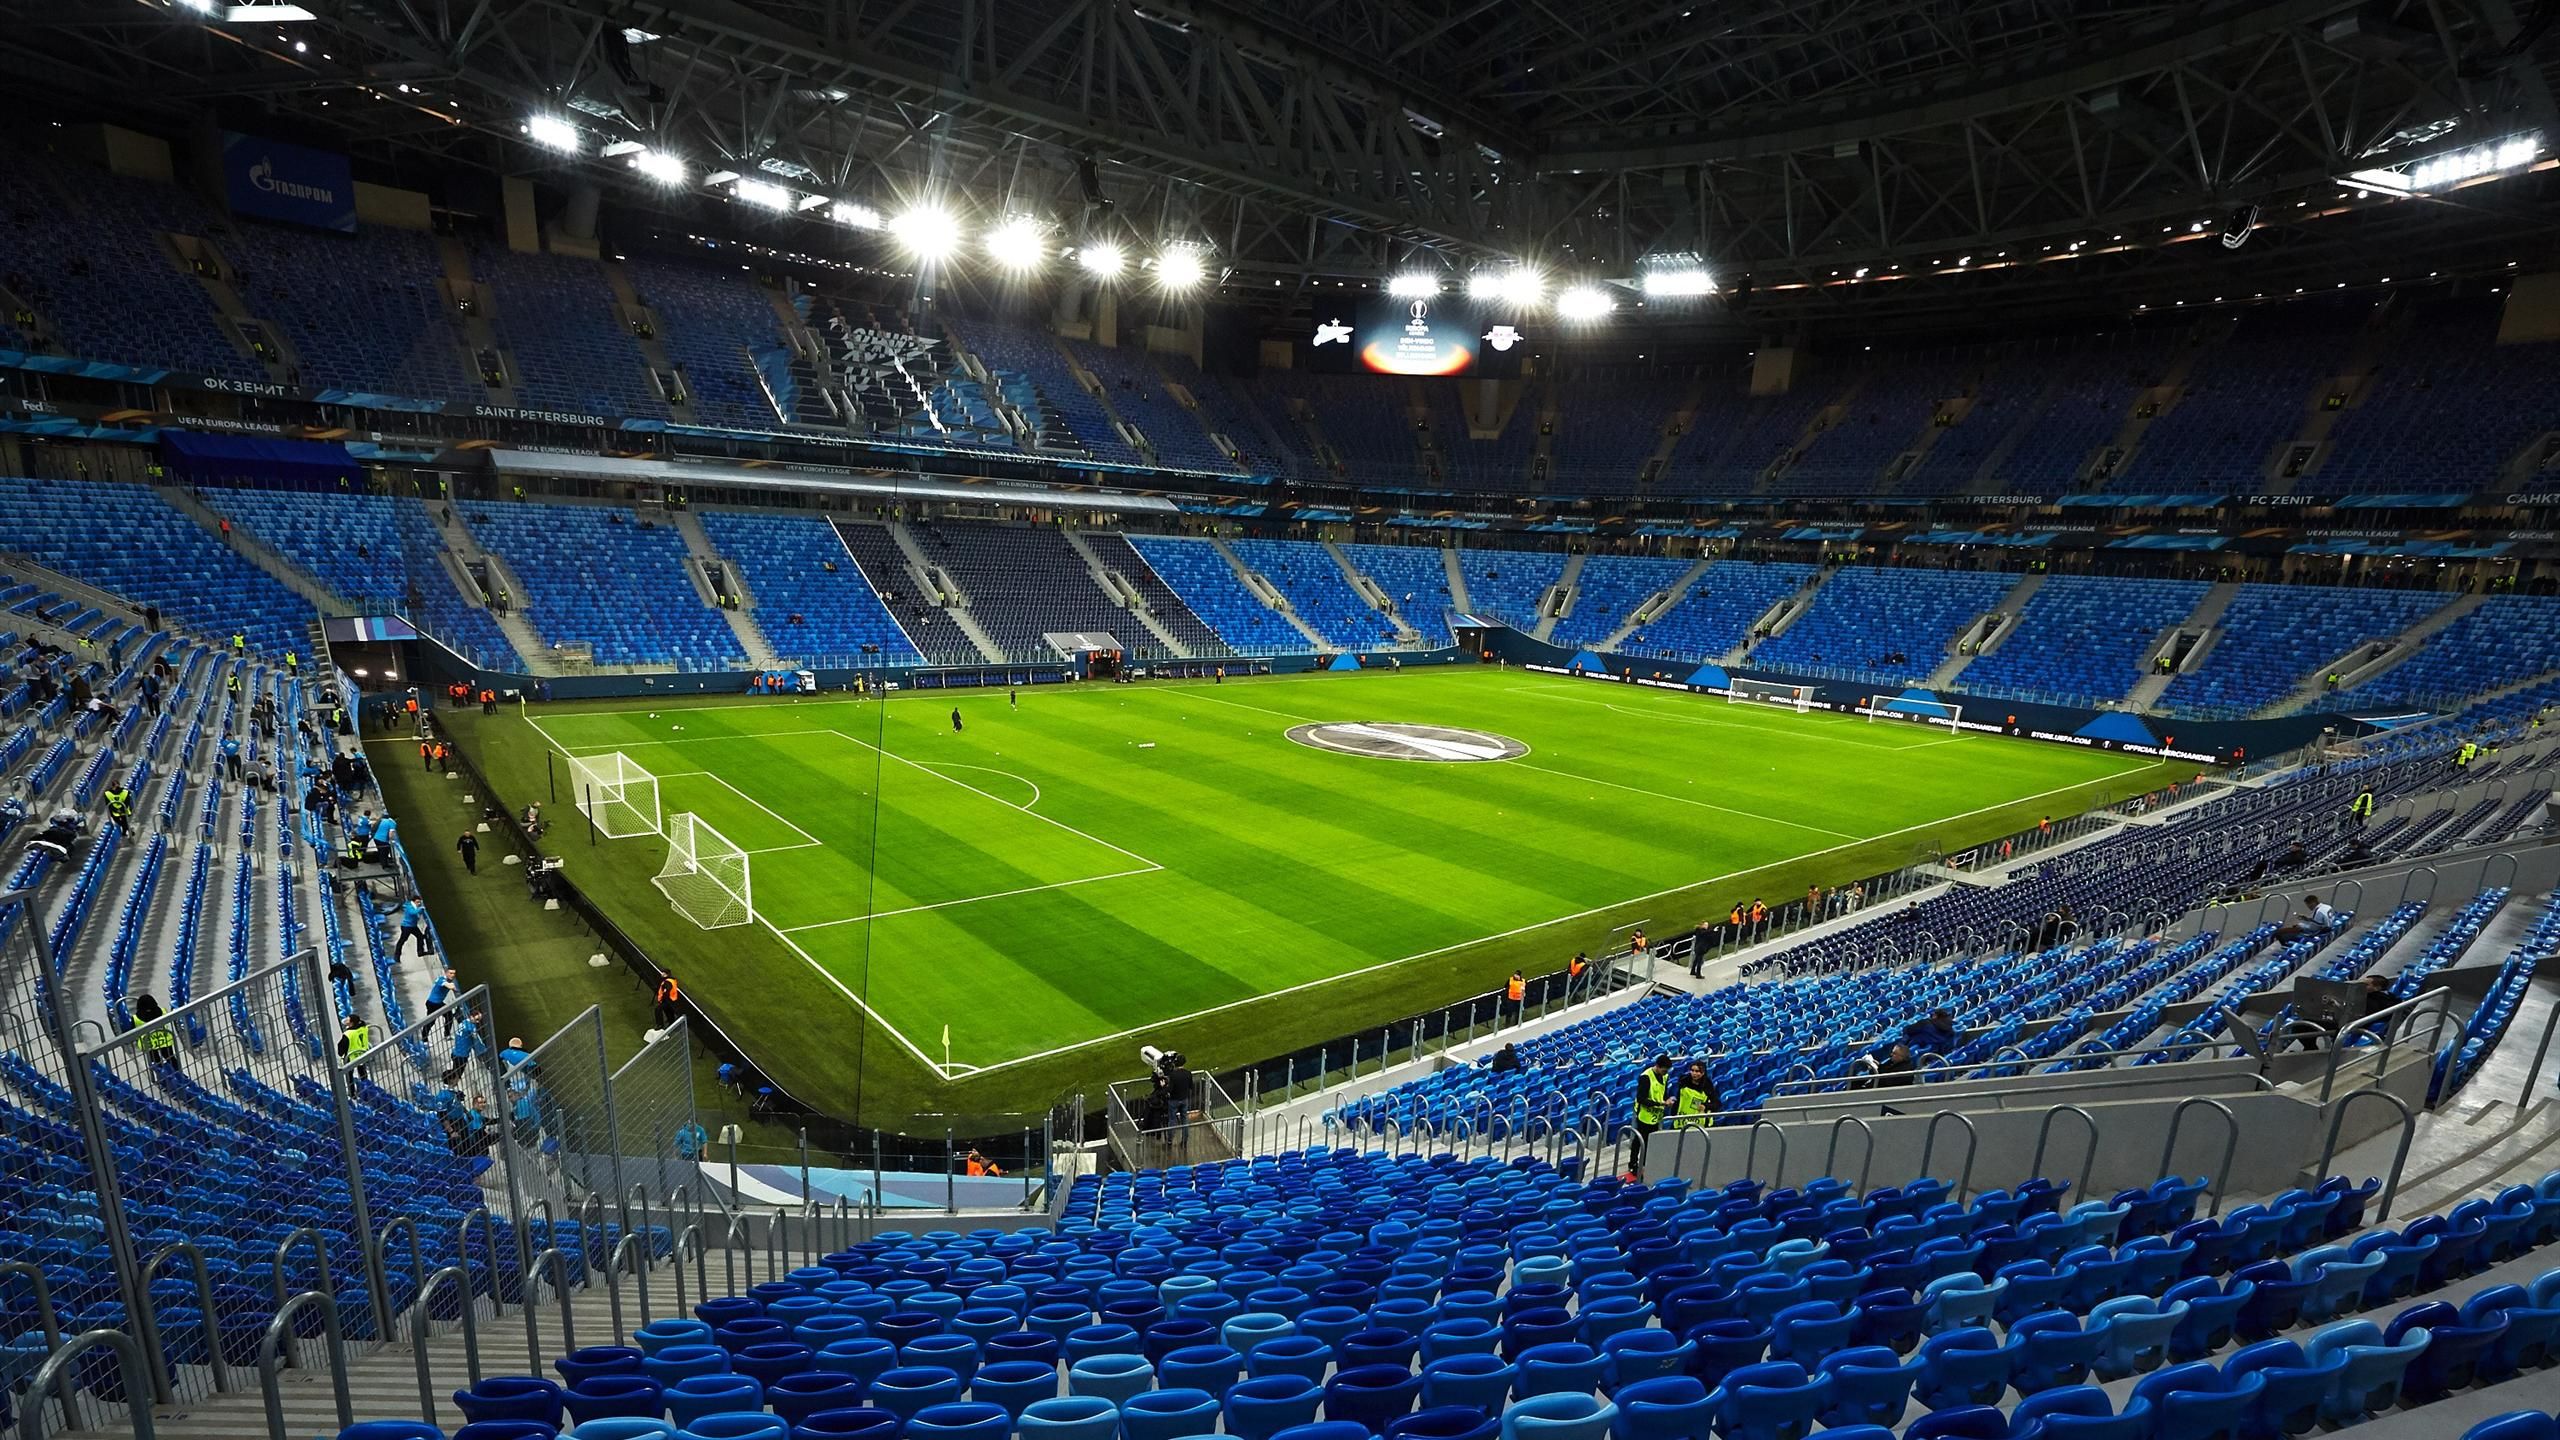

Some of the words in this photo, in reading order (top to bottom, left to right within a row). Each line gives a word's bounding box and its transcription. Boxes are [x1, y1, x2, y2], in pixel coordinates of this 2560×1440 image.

[275, 180, 333, 204] ГАЗПРОМ
[203, 377, 230, 391] ФК
[233, 380, 285, 396] ЗЕНИТ
[475, 406, 516, 418] SAINT
[520, 409, 605, 426] PETERSBURG
[178, 416, 204, 425] UEFA
[205, 418, 243, 429] EUROPA
[244, 421, 281, 432] LEAGUE
[540, 447, 570, 455] EUROPA
[571, 448, 601, 457] LEAGUE
[1972, 496, 2043, 504] PETERSBURG
[2249, 496, 2268, 504] FC
[2271, 496, 2314, 505] ZENIT
[2365, 530, 2400, 538] LEAGUE
[1793, 699, 1831, 709] MERCHANDSE
[2031, 731, 2092, 745] STORE.UEFA.COM
[2123, 744, 2158, 755] OFFICIAL
[2159, 748, 2216, 763] MERCHANDISE
